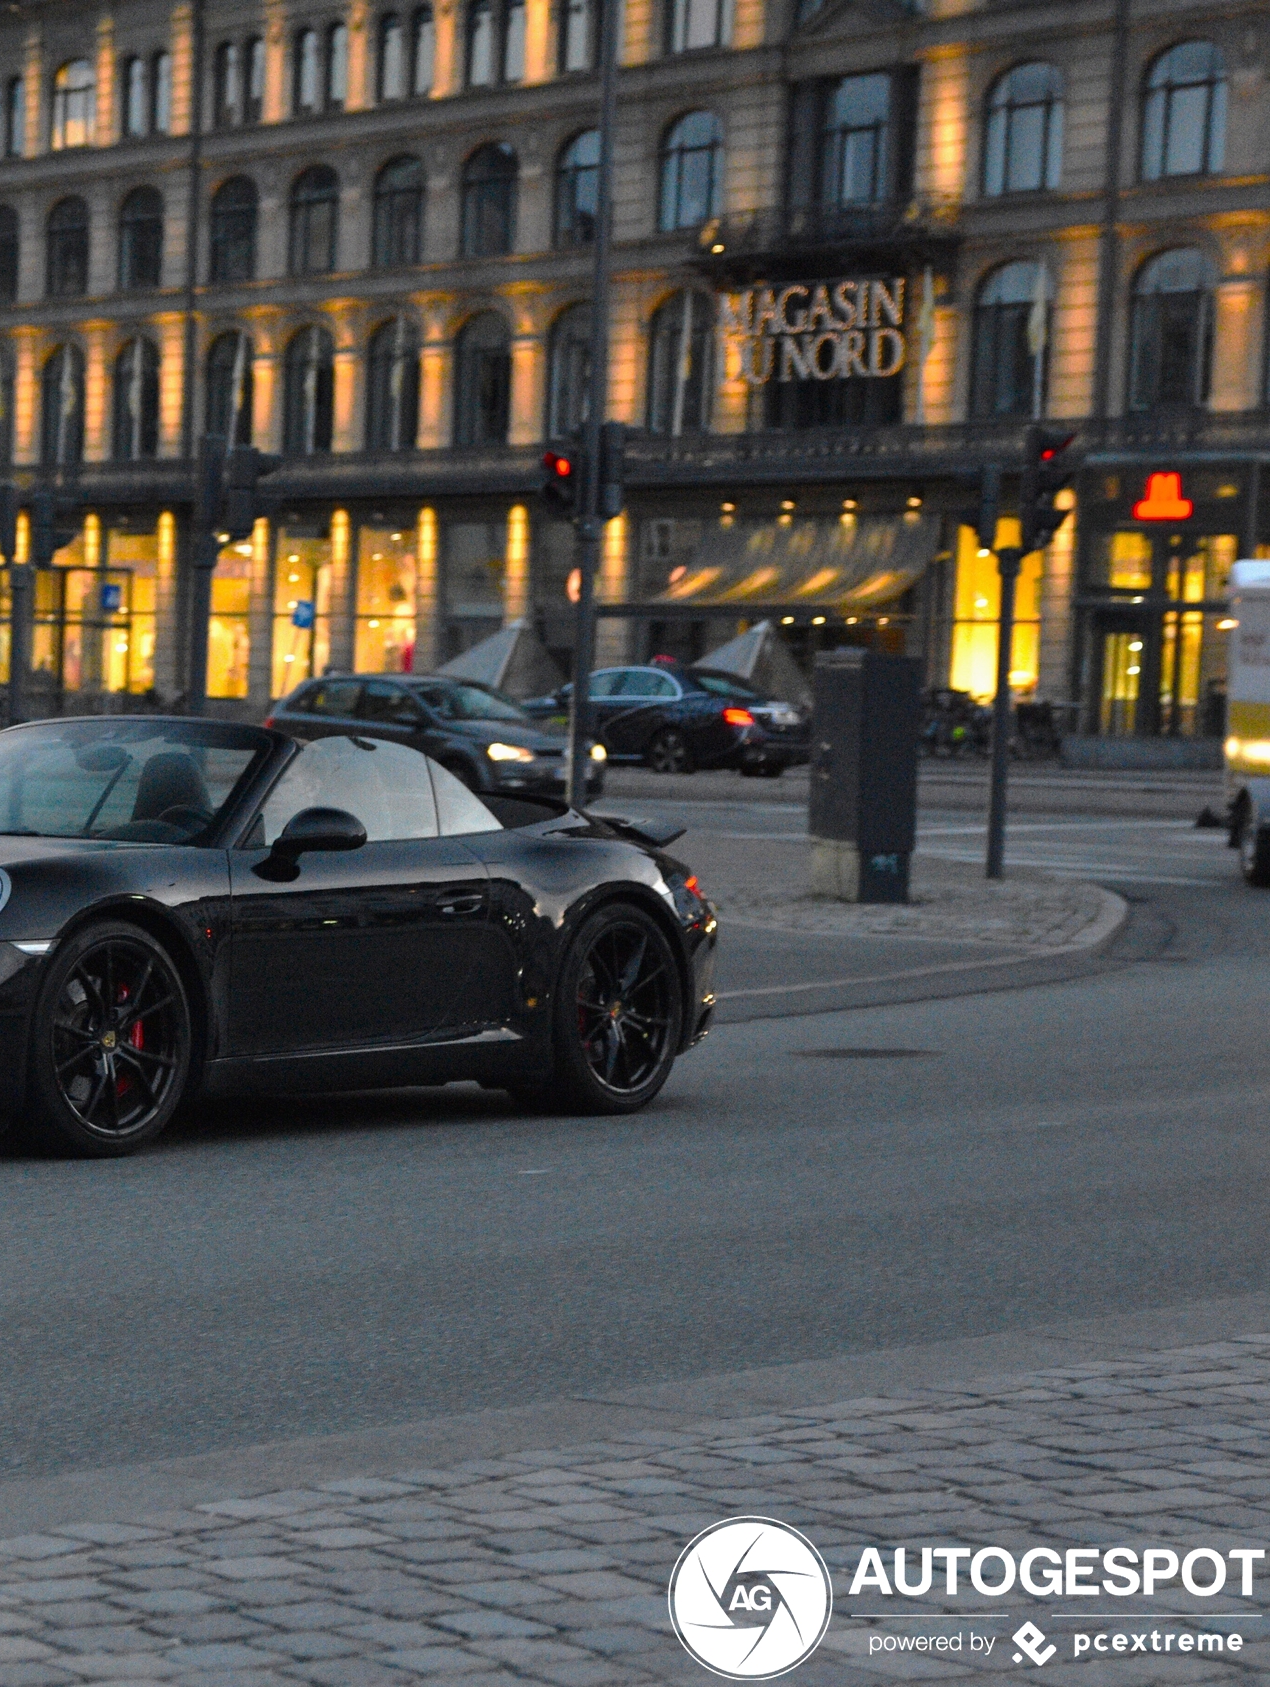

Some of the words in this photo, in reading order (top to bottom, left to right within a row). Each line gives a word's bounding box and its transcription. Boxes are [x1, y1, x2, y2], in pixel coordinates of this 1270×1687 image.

[718, 277, 906, 335] MAGASIN
[718, 334, 774, 385] DU
[779, 327, 906, 382] NORD
